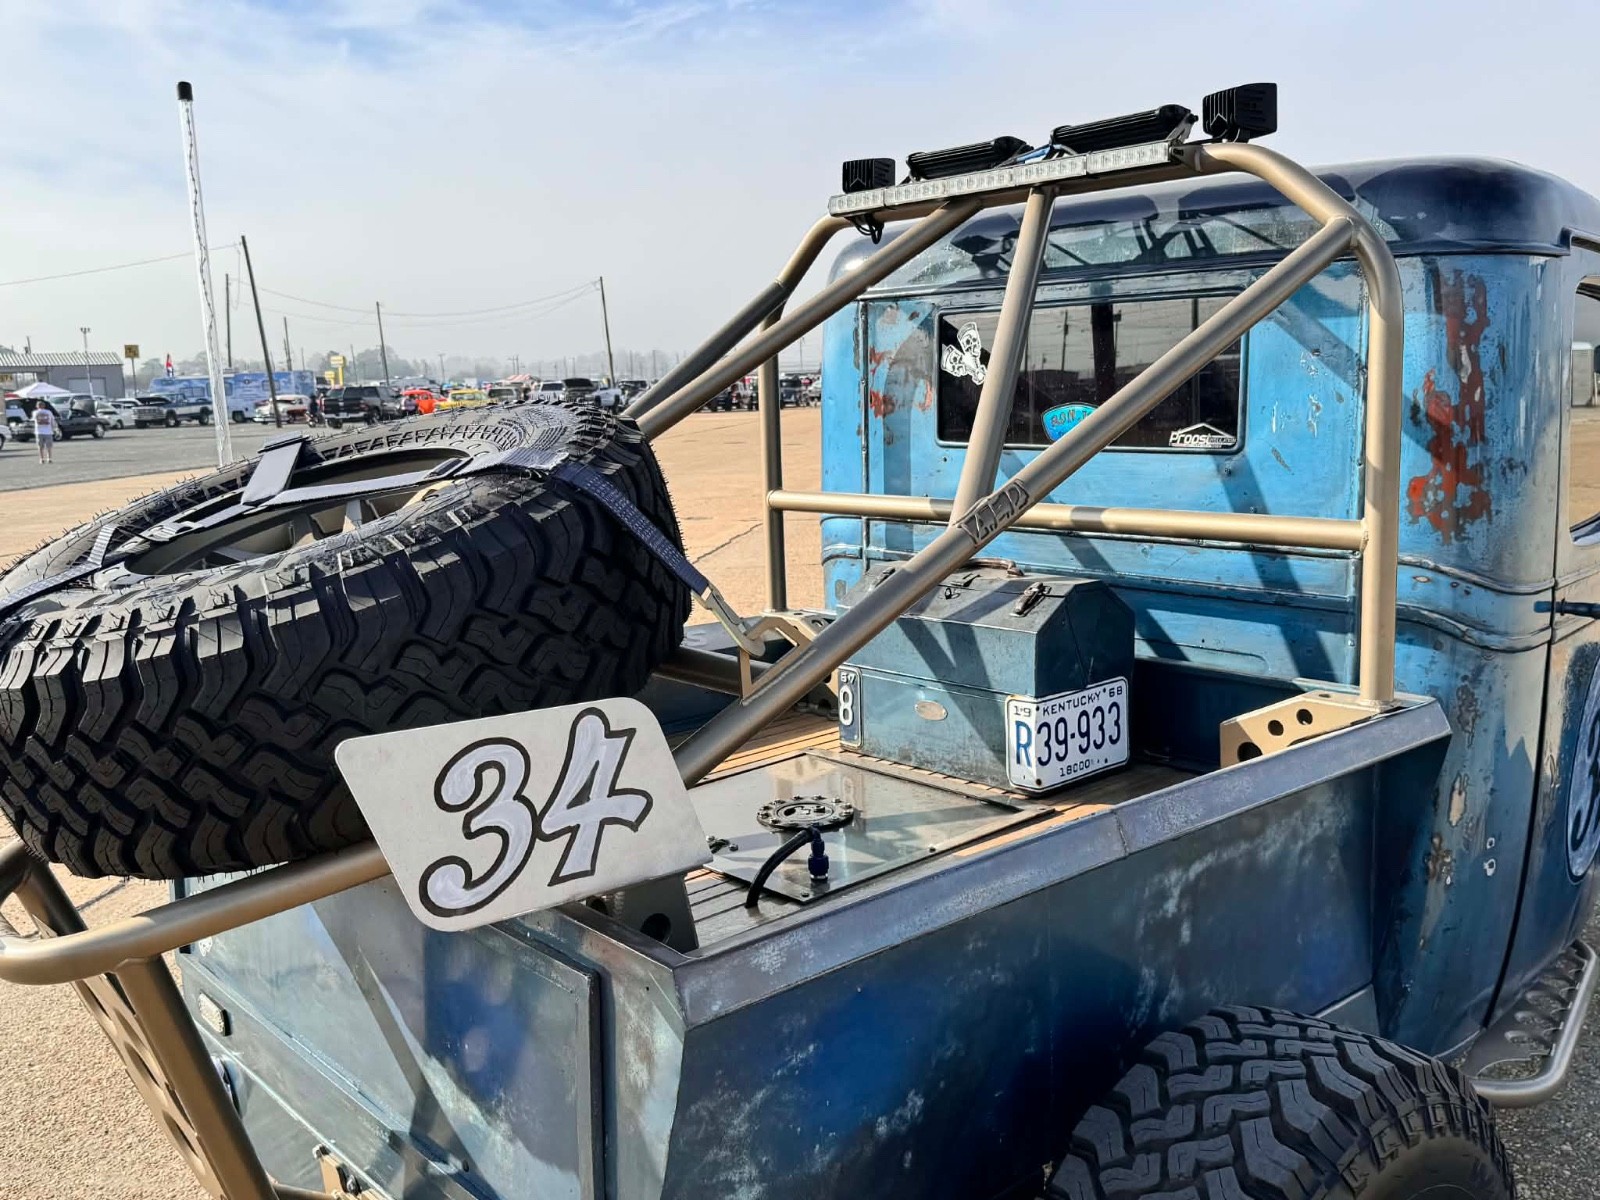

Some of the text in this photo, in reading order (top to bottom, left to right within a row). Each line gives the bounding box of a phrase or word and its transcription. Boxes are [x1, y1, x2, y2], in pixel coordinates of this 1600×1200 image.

[1169, 430, 1212, 445] Proost
[839, 685, 854, 726] 8
[1042, 690, 1101, 717] KENTUCKY
[1108, 685, 1123, 698] 68
[1059, 759, 1091, 777] 18000
[419, 706, 654, 918] 34
